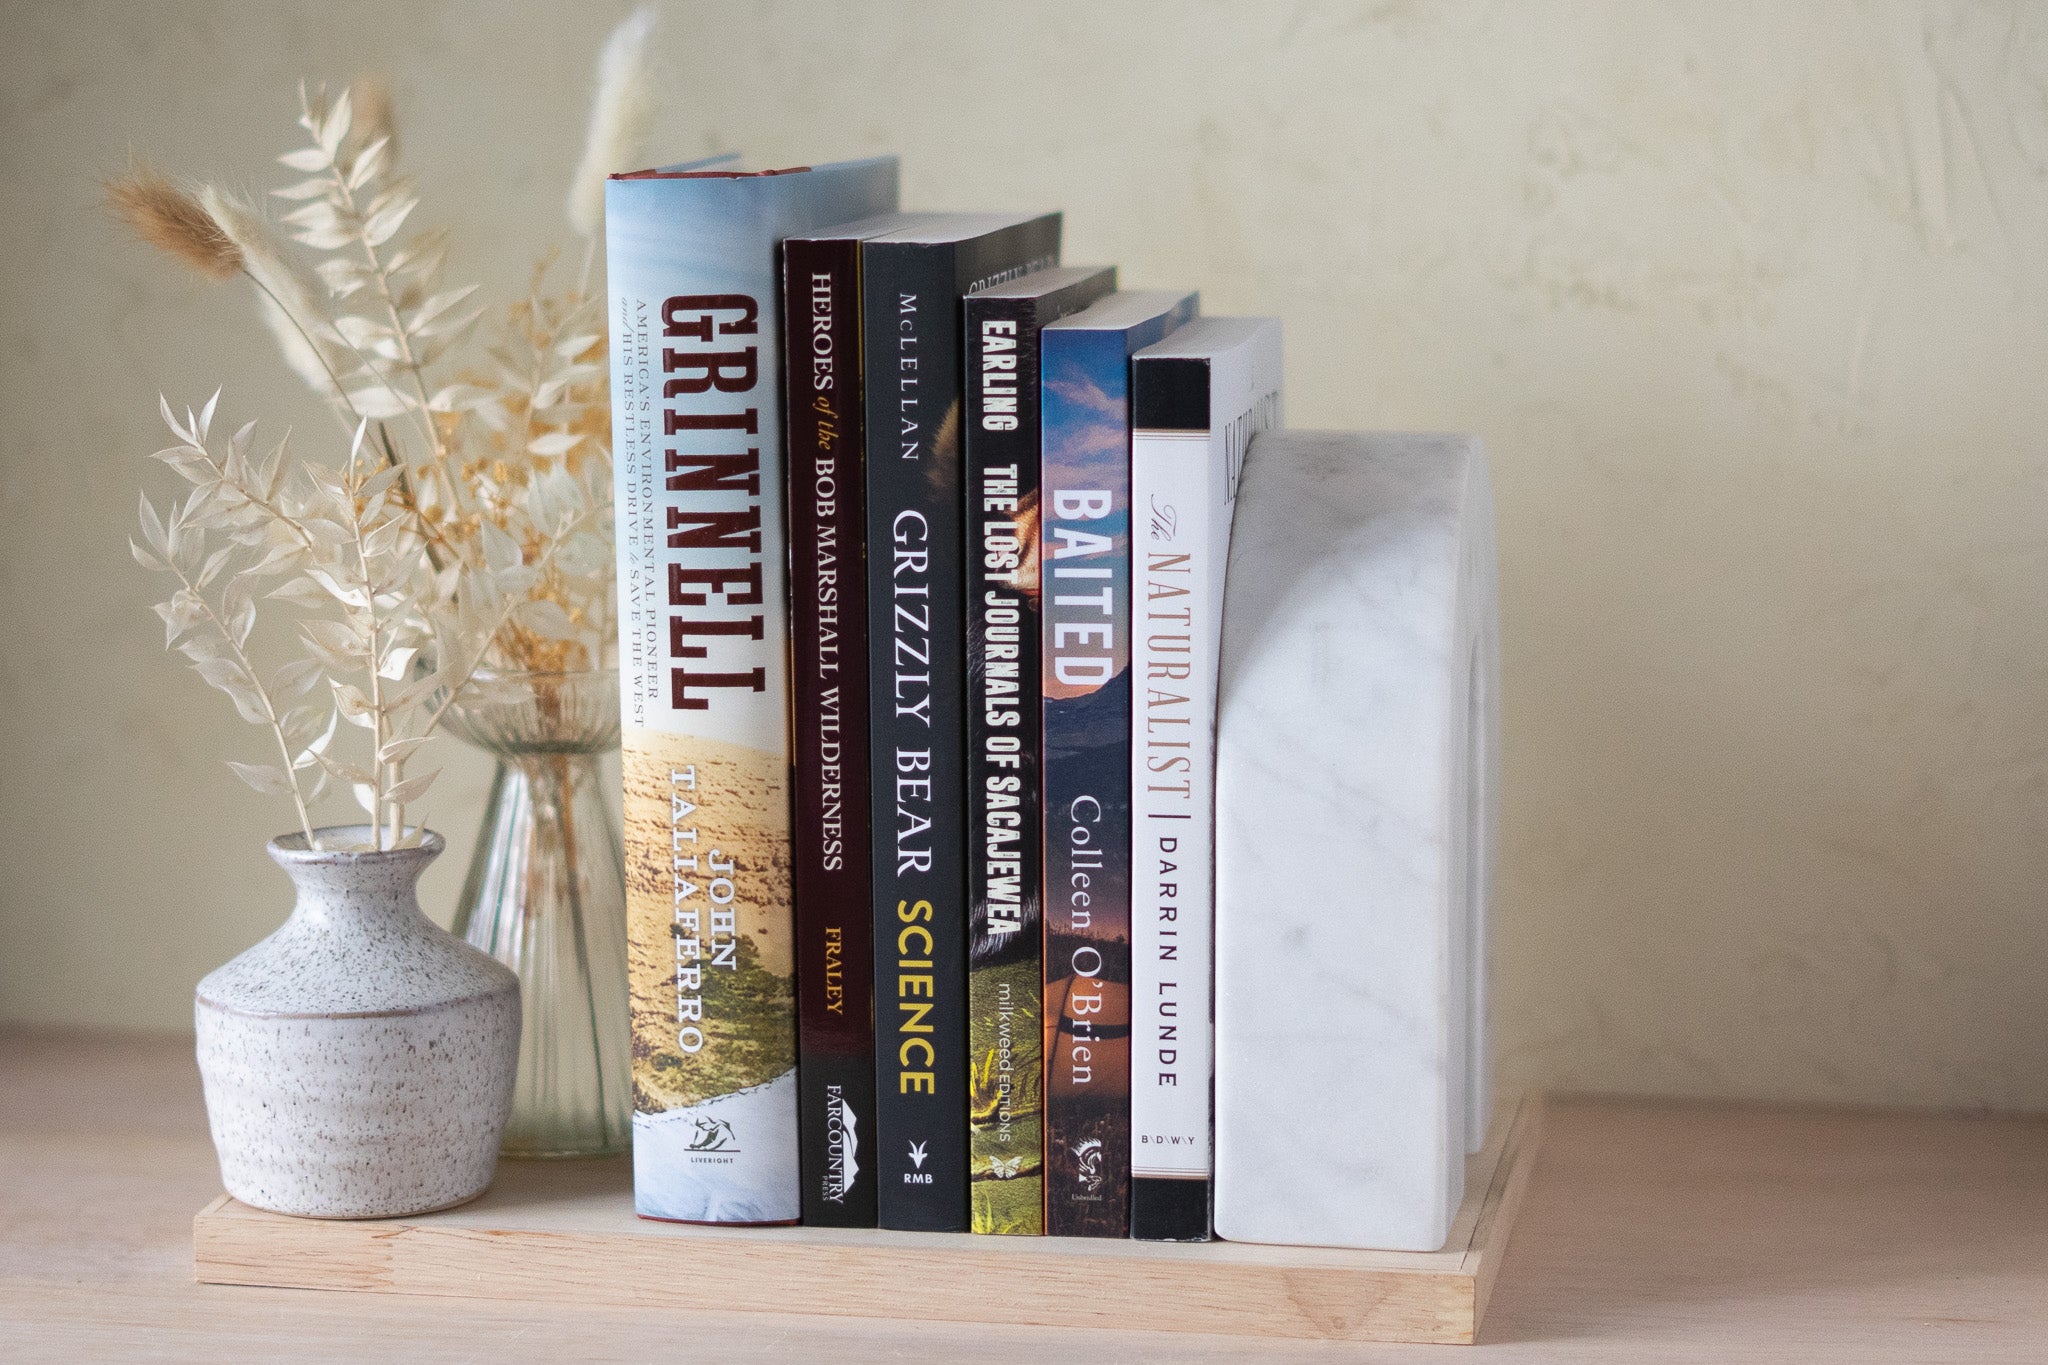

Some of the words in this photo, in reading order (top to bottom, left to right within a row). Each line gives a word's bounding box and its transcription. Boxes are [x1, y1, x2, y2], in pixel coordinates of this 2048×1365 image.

[623, 332, 634, 367] HIS
[637, 299, 650, 411] AMERICA'S
[812, 272, 834, 390] HEROES
[900, 293, 919, 460] McLELLAN
[982, 320, 1018, 431] EARLING
[624, 373, 636, 475] RESTLESS
[812, 396, 839, 419] of
[818, 420, 839, 450] the
[627, 482, 639, 547] DRIVE
[640, 420, 655, 602] ENVIRONMENTAL
[661, 294, 766, 711] GRINNELL
[815, 457, 836, 517] BOB
[983, 464, 1018, 512] THE
[1150, 494, 1177, 542] The
[630, 570, 641, 622] SAVE
[817, 524, 839, 680] MARSHALL
[984, 521, 1020, 585] LOST
[1053, 489, 1113, 686] BAITED
[632, 628, 643, 667] THE
[646, 608, 659, 699] PIONEER
[893, 510, 930, 728] GRIZZLY
[984, 591, 1021, 726] JOURNALS
[634, 674, 645, 727] WEST
[1147, 552, 1191, 799] NATURALIST
[820, 686, 843, 871] WILDERNESS
[986, 737, 1021, 769] OF
[896, 746, 932, 878] BEAR
[986, 776, 1022, 935] SACAJEWEA
[1070, 795, 1103, 930] Colleen
[671, 765, 704, 1054] TALIAFERRO
[708, 848, 738, 970] JOHN
[1159, 836, 1177, 961] DARRIN
[825, 927, 843, 1015] FRALEY
[897, 899, 935, 1094] SCIENCE
[1071, 946, 1104, 1085] O'Brien
[998, 984, 1014, 1071] milkweed
[1158, 982, 1177, 1087] LUNDE
[690, 1157, 735, 1165] LIVERIGHT
[827, 1085, 844, 1204] FARCOUNTRY
[999, 1074, 1011, 1141] EDITIONS
[904, 1173, 933, 1184] RMB
